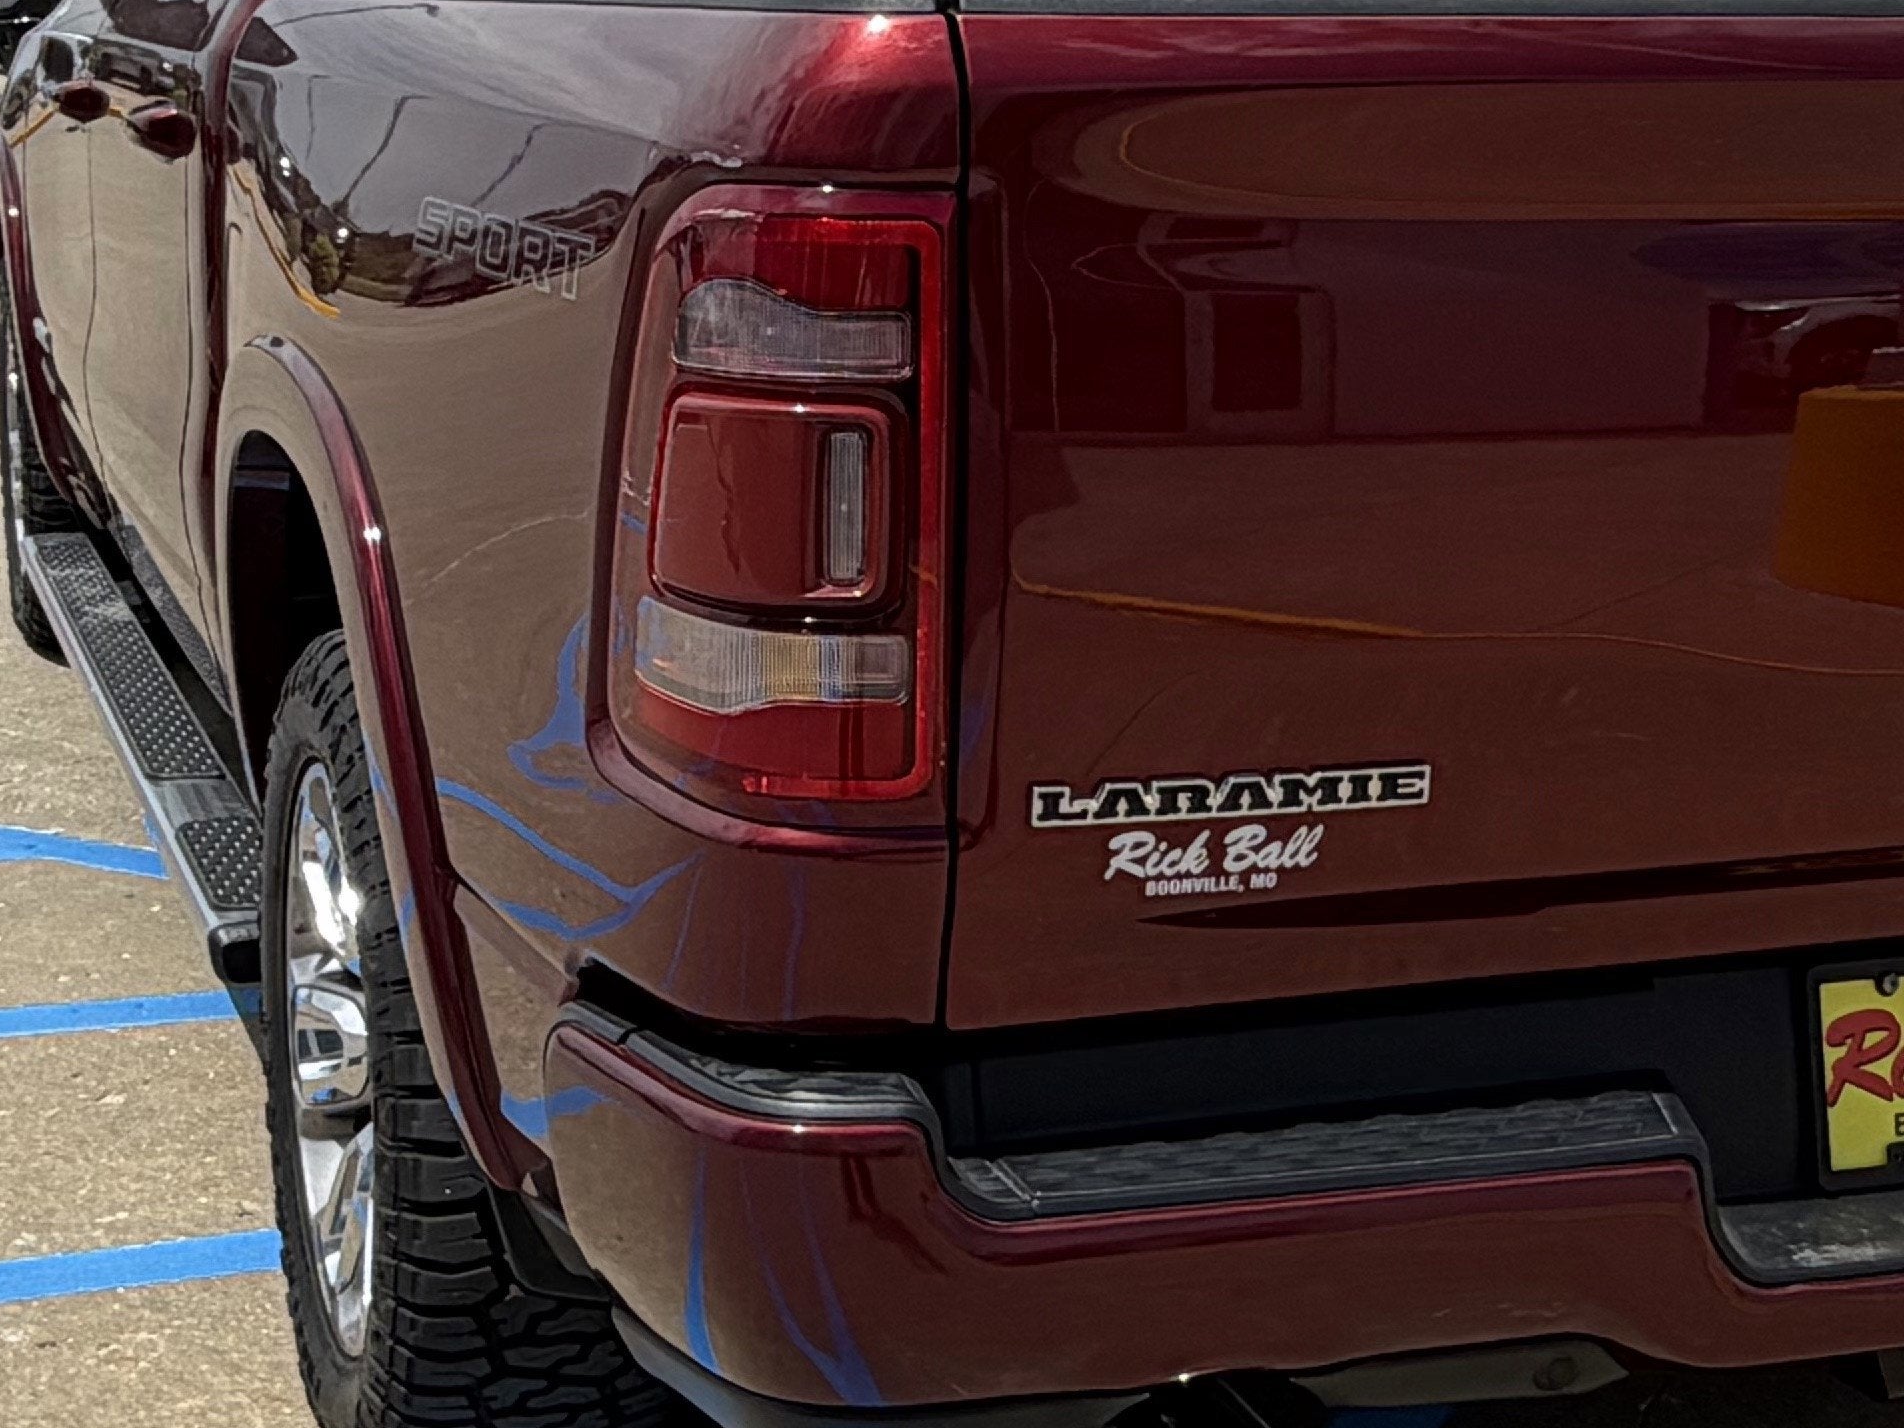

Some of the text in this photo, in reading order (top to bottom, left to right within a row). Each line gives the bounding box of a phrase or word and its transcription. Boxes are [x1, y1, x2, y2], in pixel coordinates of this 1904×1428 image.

[412, 196, 596, 301] SPORT
[1031, 765, 1431, 828] LARAMIE
[1104, 823, 1324, 881] Rick Ball
[1145, 872, 1278, 897] BOONVILLE, MO
